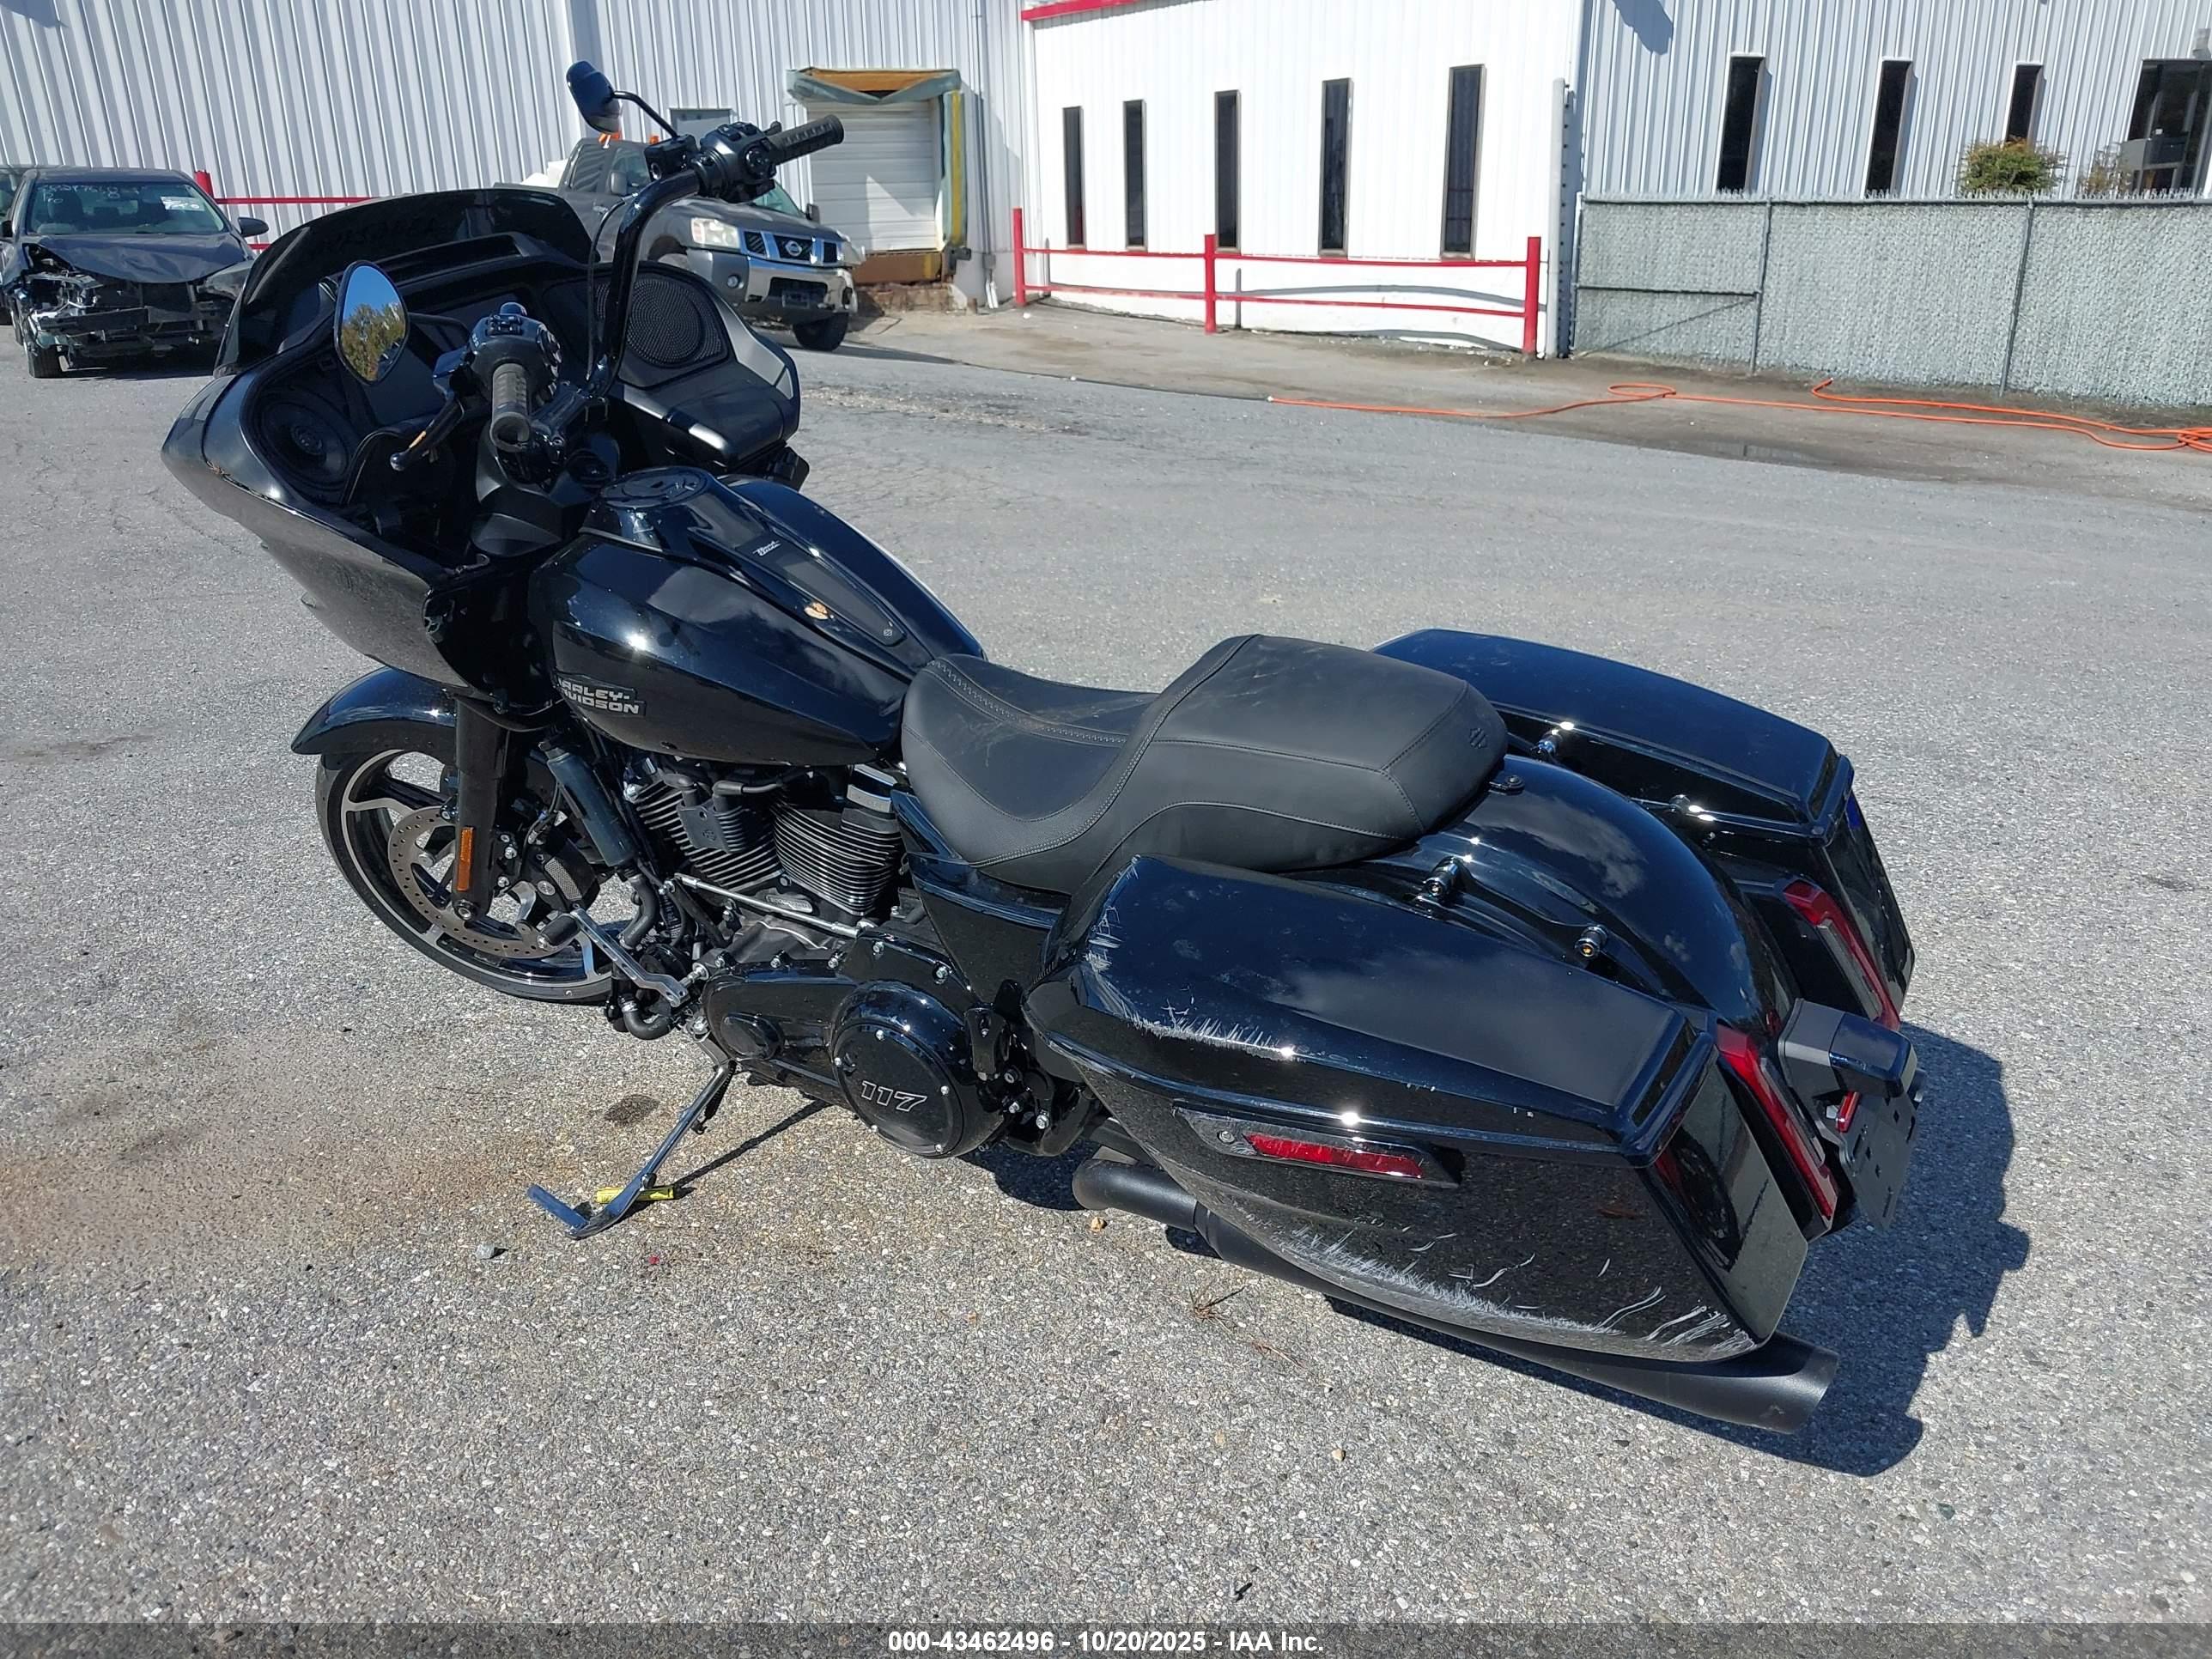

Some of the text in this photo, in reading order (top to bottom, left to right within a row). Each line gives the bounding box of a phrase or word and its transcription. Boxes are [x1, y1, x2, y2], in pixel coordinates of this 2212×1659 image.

[558, 678, 630, 702] ARLEY-
[561, 686, 640, 714] VIDSON
[861, 1080, 928, 1112] 117
